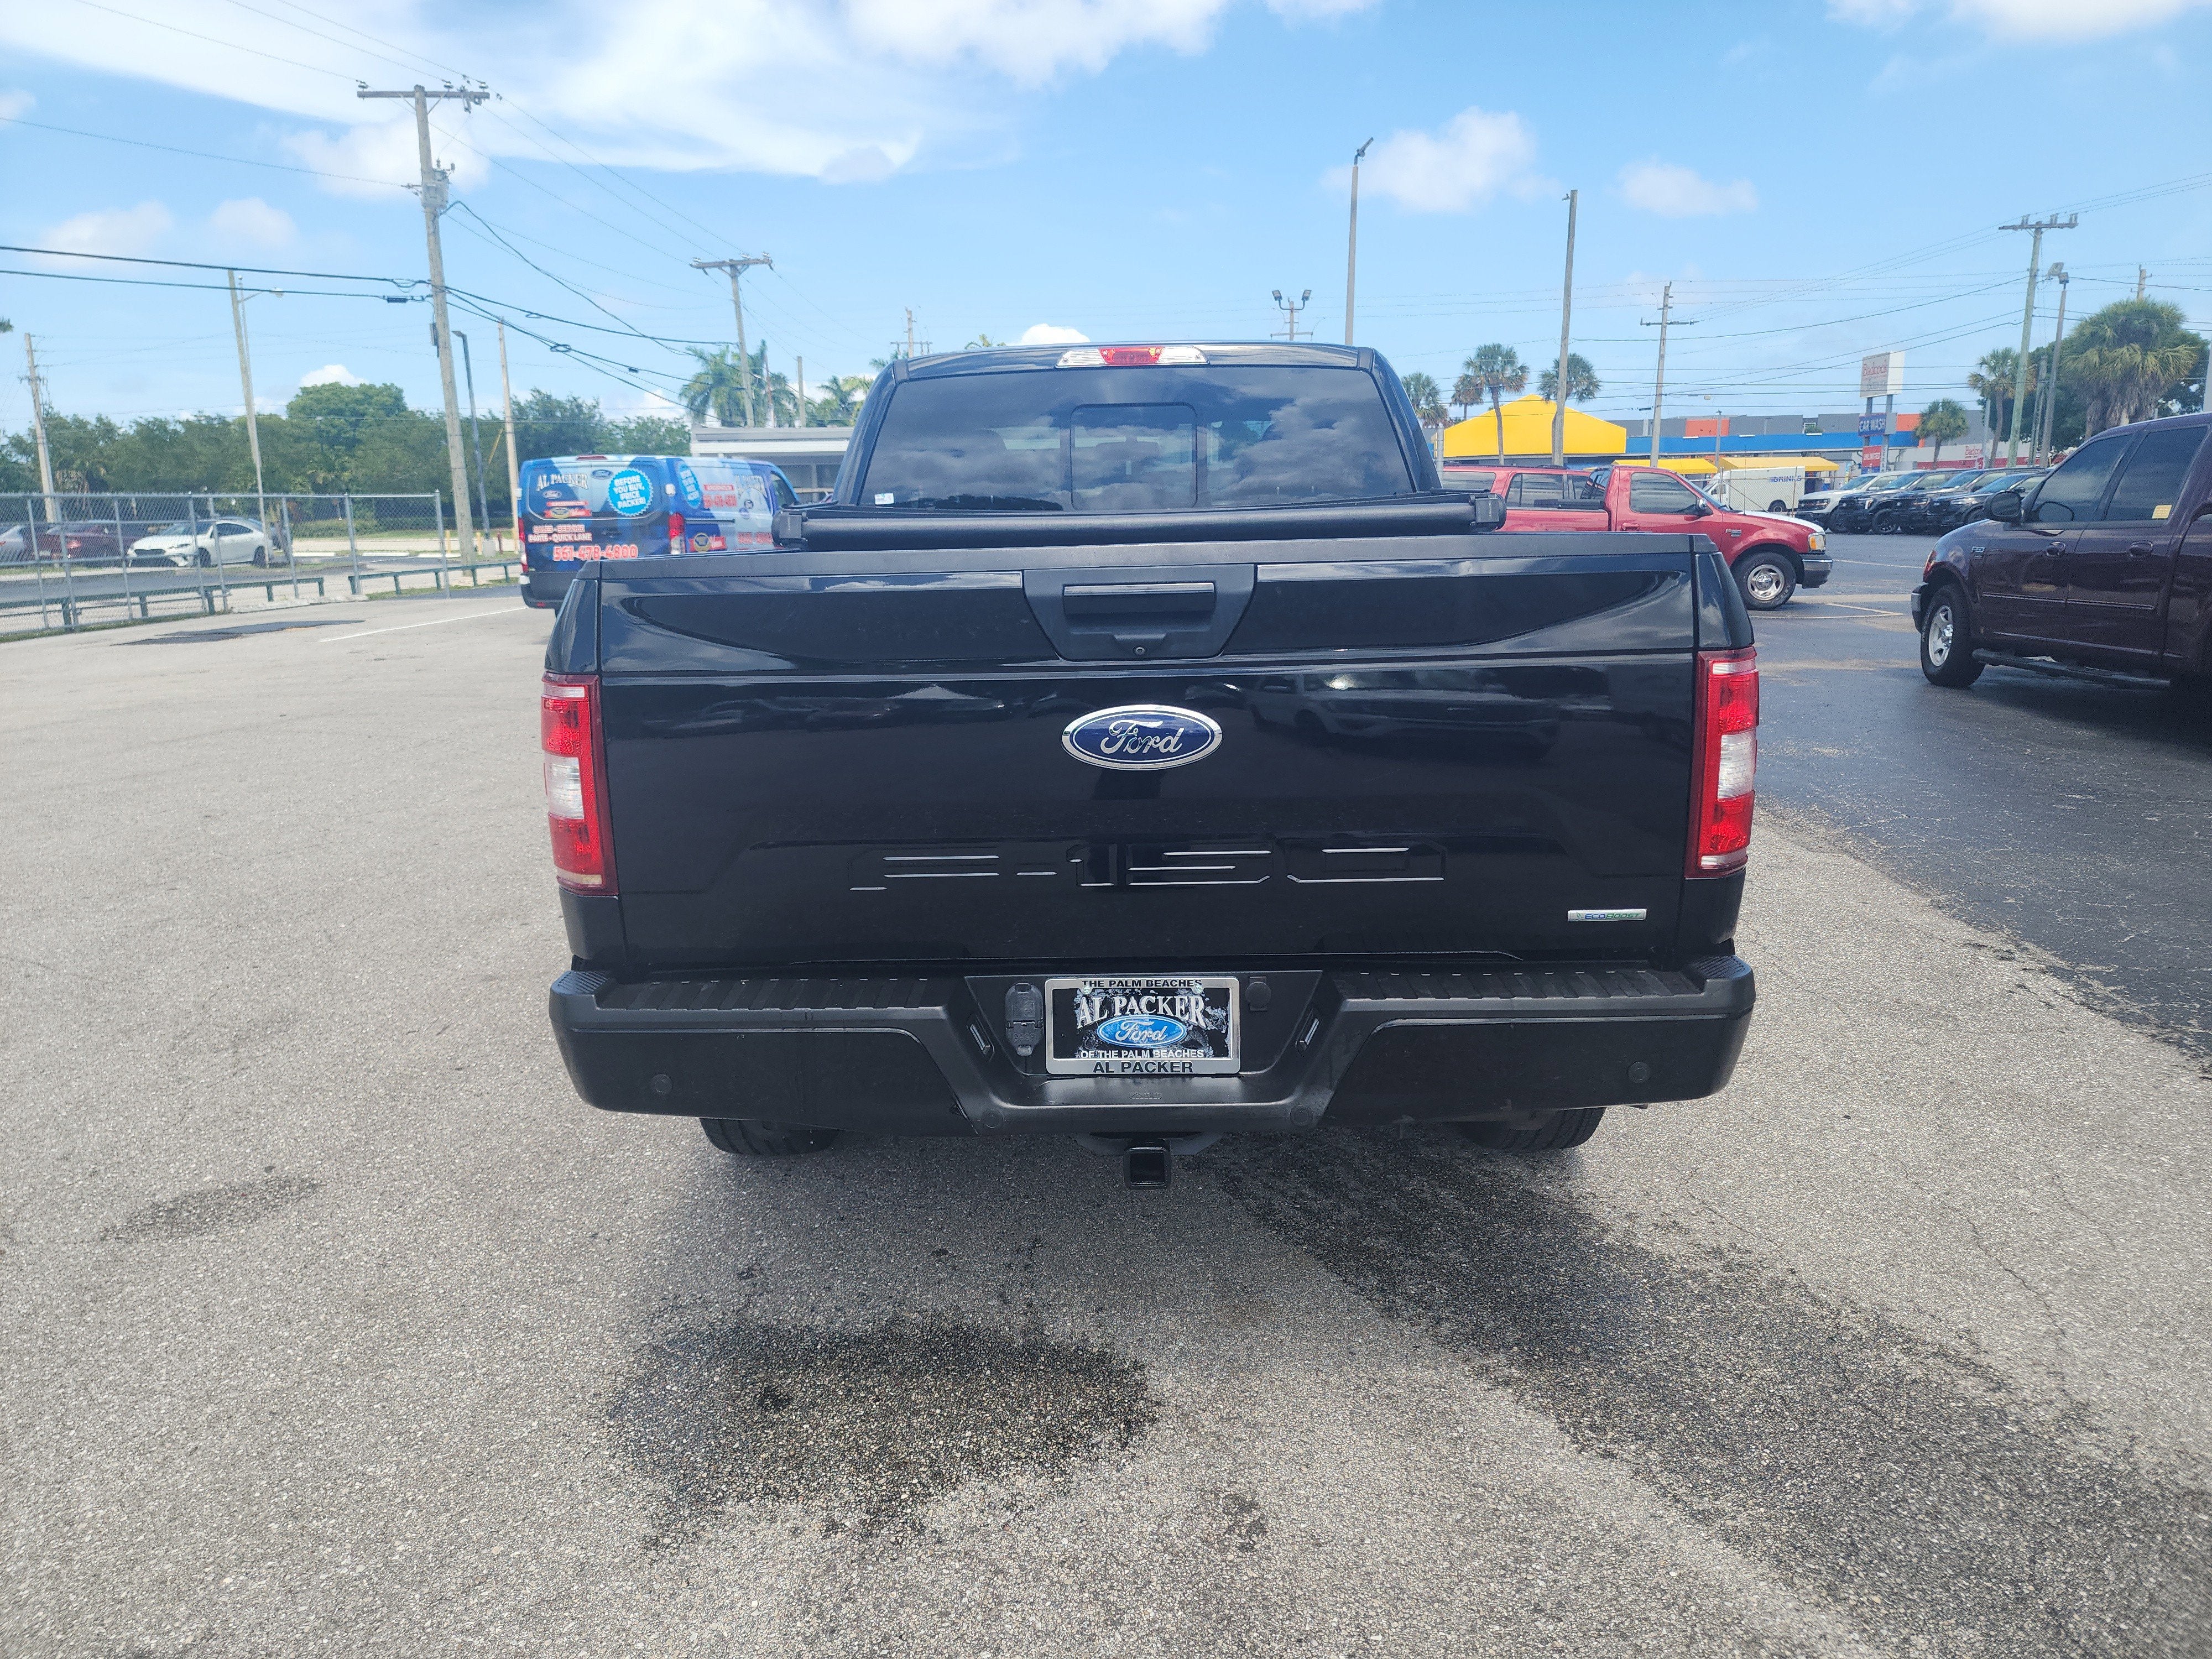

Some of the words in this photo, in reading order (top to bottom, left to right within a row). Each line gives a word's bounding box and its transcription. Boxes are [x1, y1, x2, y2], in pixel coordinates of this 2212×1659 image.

[1859, 420, 1869, 432] CAR
[1870, 418, 1886, 430] WASH
[536, 474, 550, 491] AL
[550, 473, 588, 490] PACKER
[614, 475, 641, 486] BEFORE
[613, 485, 629, 494] YOU
[619, 491, 640, 500] PRICE
[552, 533, 574, 542] QUICK
[574, 533, 592, 541] LANE
[553, 544, 638, 561] 561-478-4800
[1100, 719, 1185, 754] Ford
[1082, 979, 1108, 988] THE
[1109, 979, 1142, 988] PALM
[1146, 979, 1203, 988] BEACHES
[1077, 996, 1109, 1029] AL
[1112, 995, 1208, 1030] PACKER
[1114, 1018, 1168, 1042] Ford
[1080, 1050, 1096, 1059] OF
[1098, 1050, 1119, 1059] THE
[1122, 1050, 1150, 1059] PALM
[1153, 1049, 1204, 1058] BEACHES
[1093, 1062, 1115, 1073] AL
[1120, 1061, 1194, 1073] PACKER
